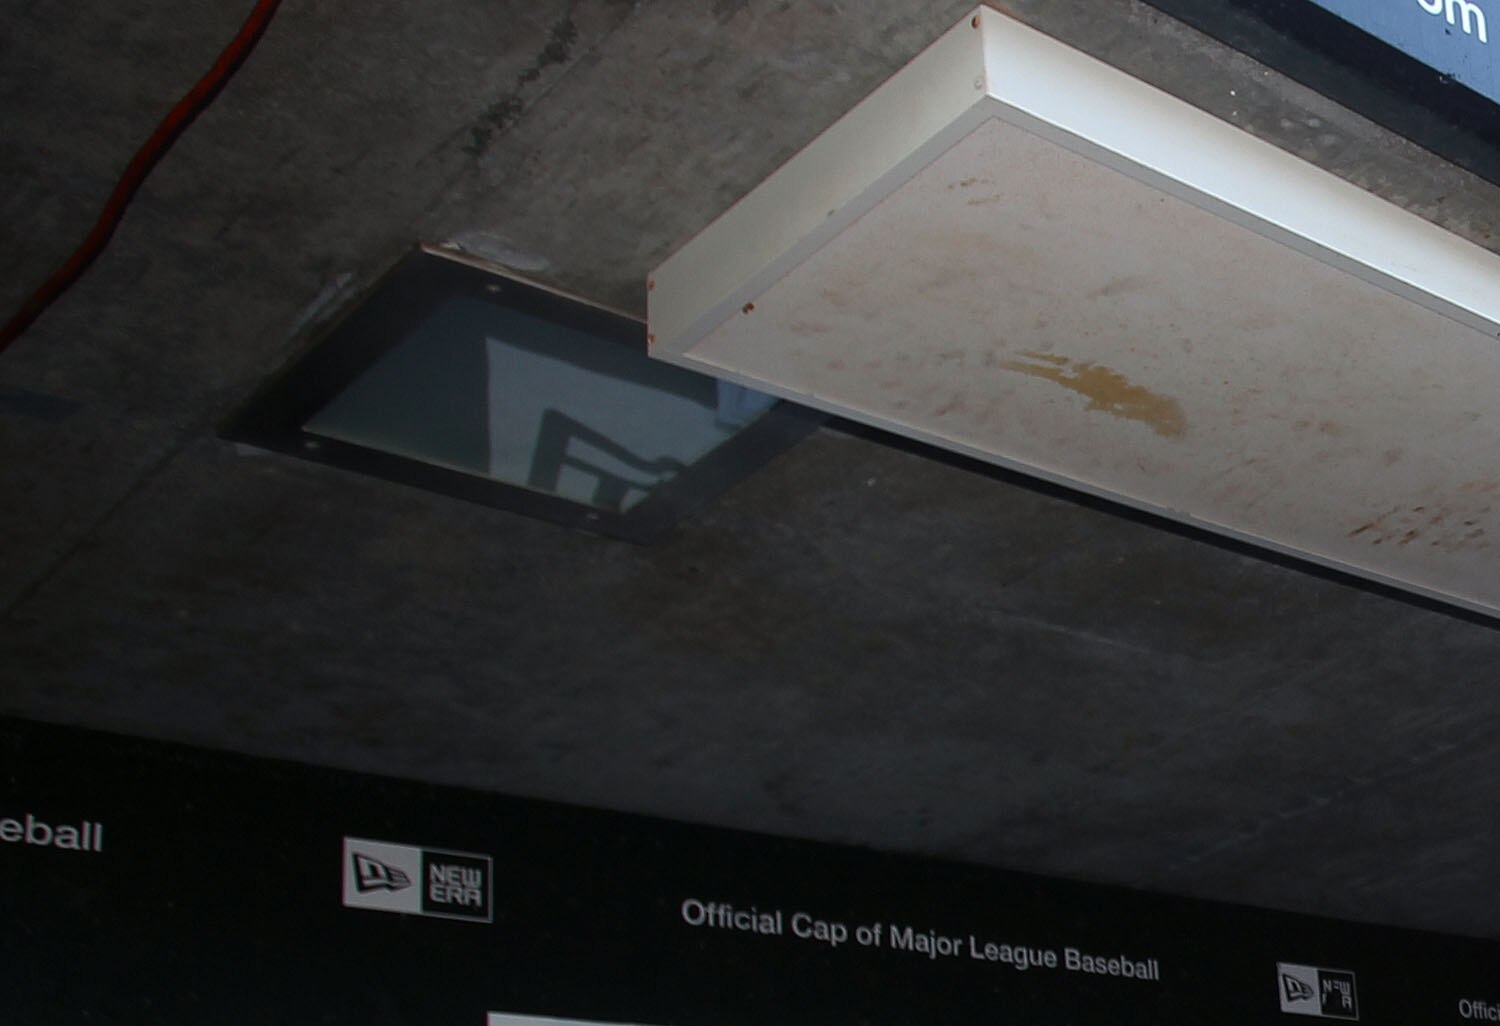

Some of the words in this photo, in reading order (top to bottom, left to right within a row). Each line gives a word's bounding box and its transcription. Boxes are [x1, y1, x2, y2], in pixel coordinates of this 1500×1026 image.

[428, 863, 483, 889] NEW
[429, 884, 483, 907] ERA
[681, 899, 783, 936] Official
[791, 913, 847, 946] Cap
[856, 923, 883, 946] of
[890, 925, 963, 960] Major
[969, 936, 1058, 970] League
[1064, 948, 1160, 981] Baseball
